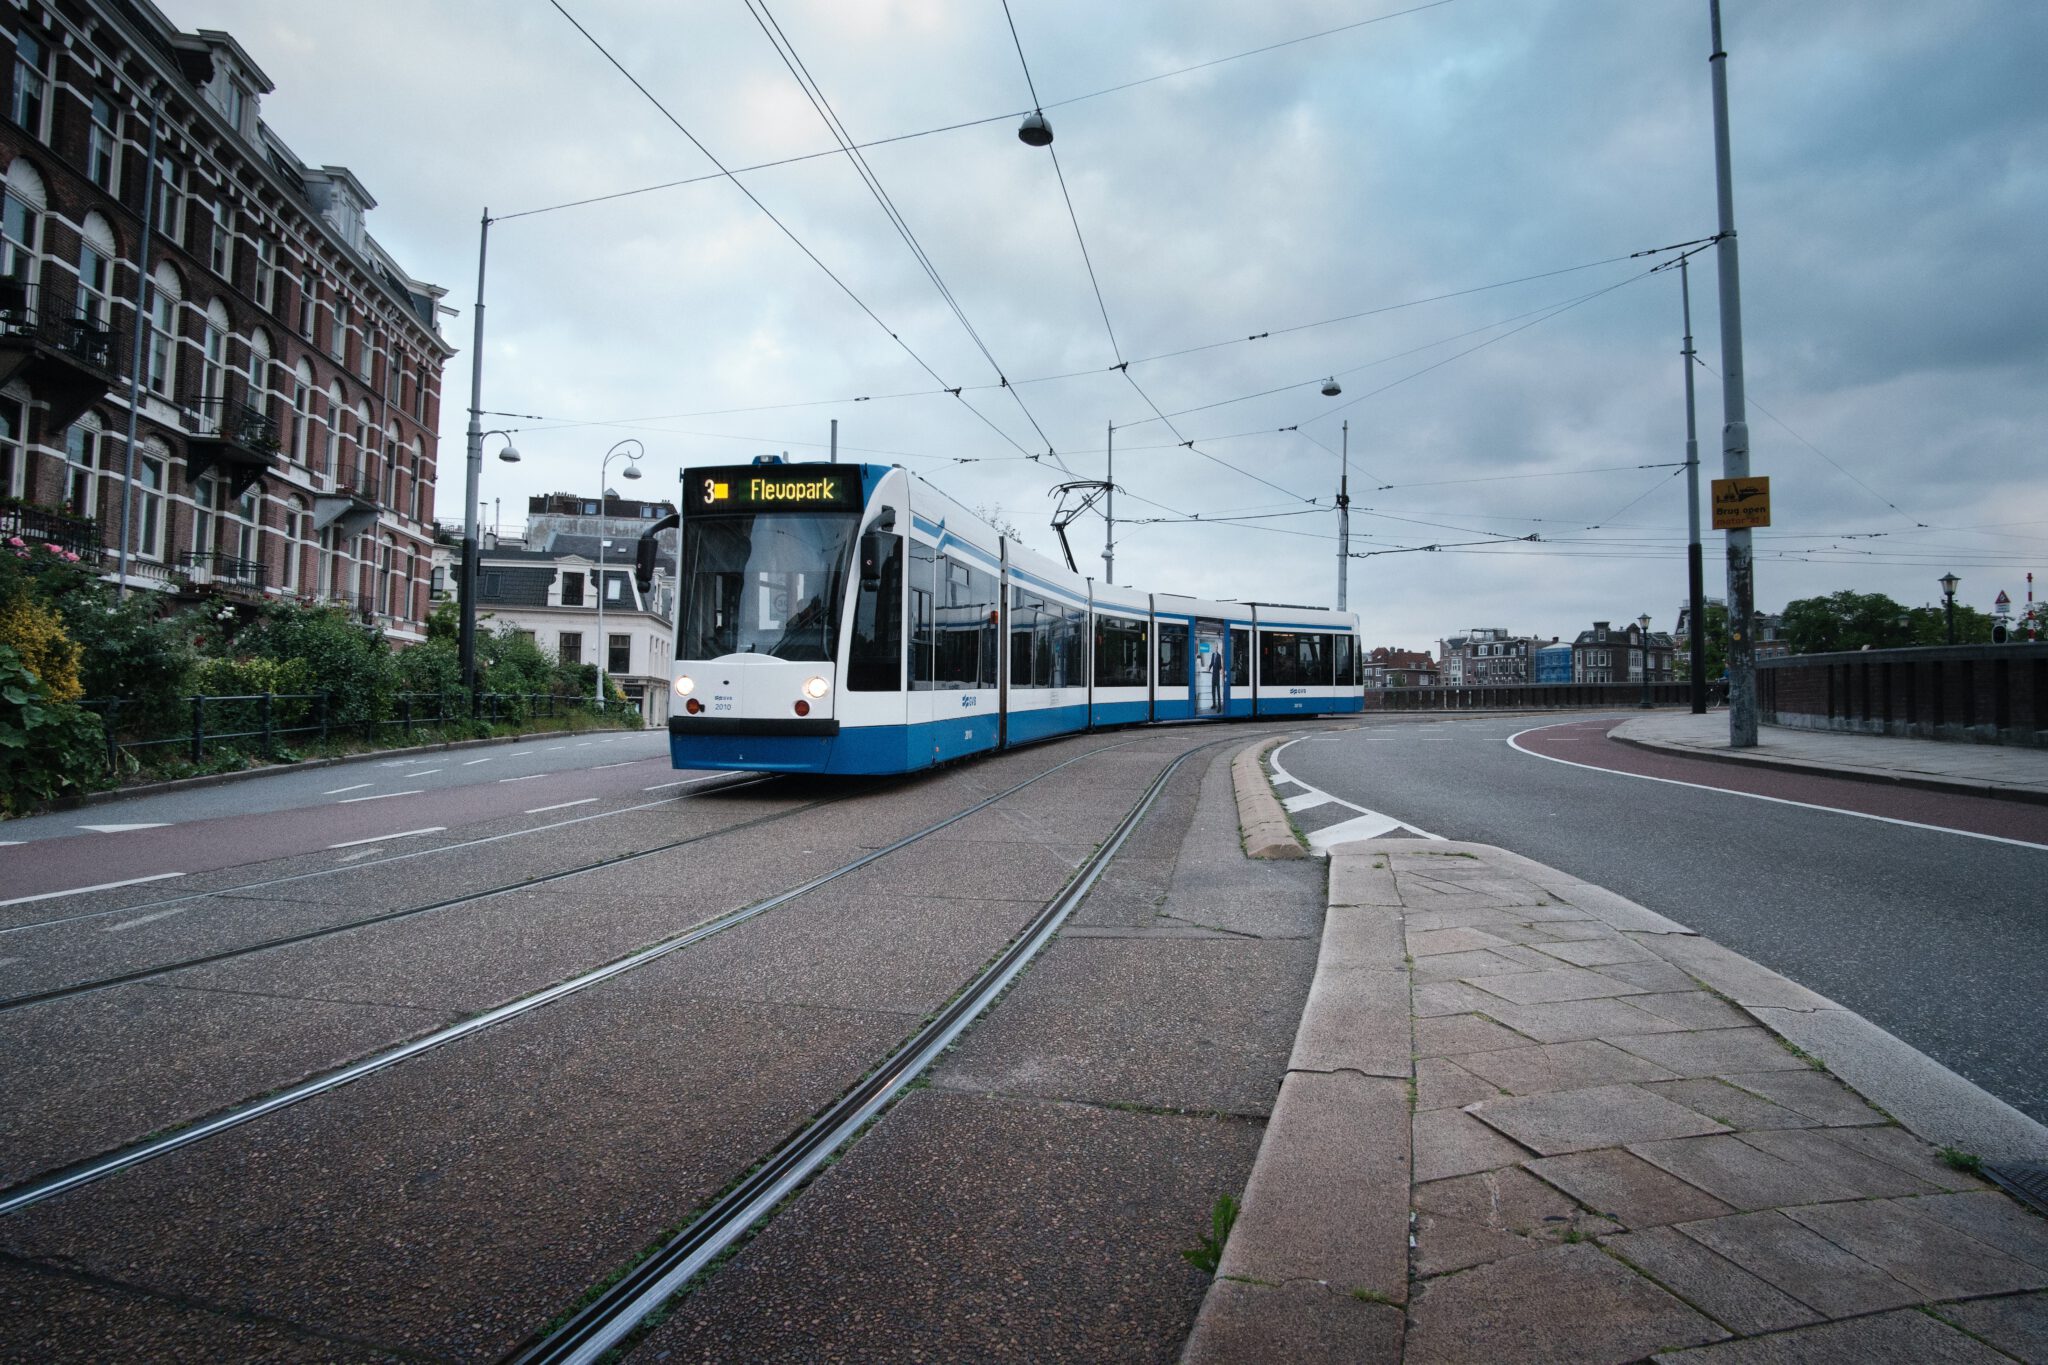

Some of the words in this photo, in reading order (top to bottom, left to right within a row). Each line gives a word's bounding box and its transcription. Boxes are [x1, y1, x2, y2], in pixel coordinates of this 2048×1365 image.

[704, 479, 715, 504] 3
[751, 478, 835, 501] Flevopark
[1716, 508, 1739, 516] Brug
[1743, 506, 1766, 514] open
[715, 703, 732, 711] 2010
